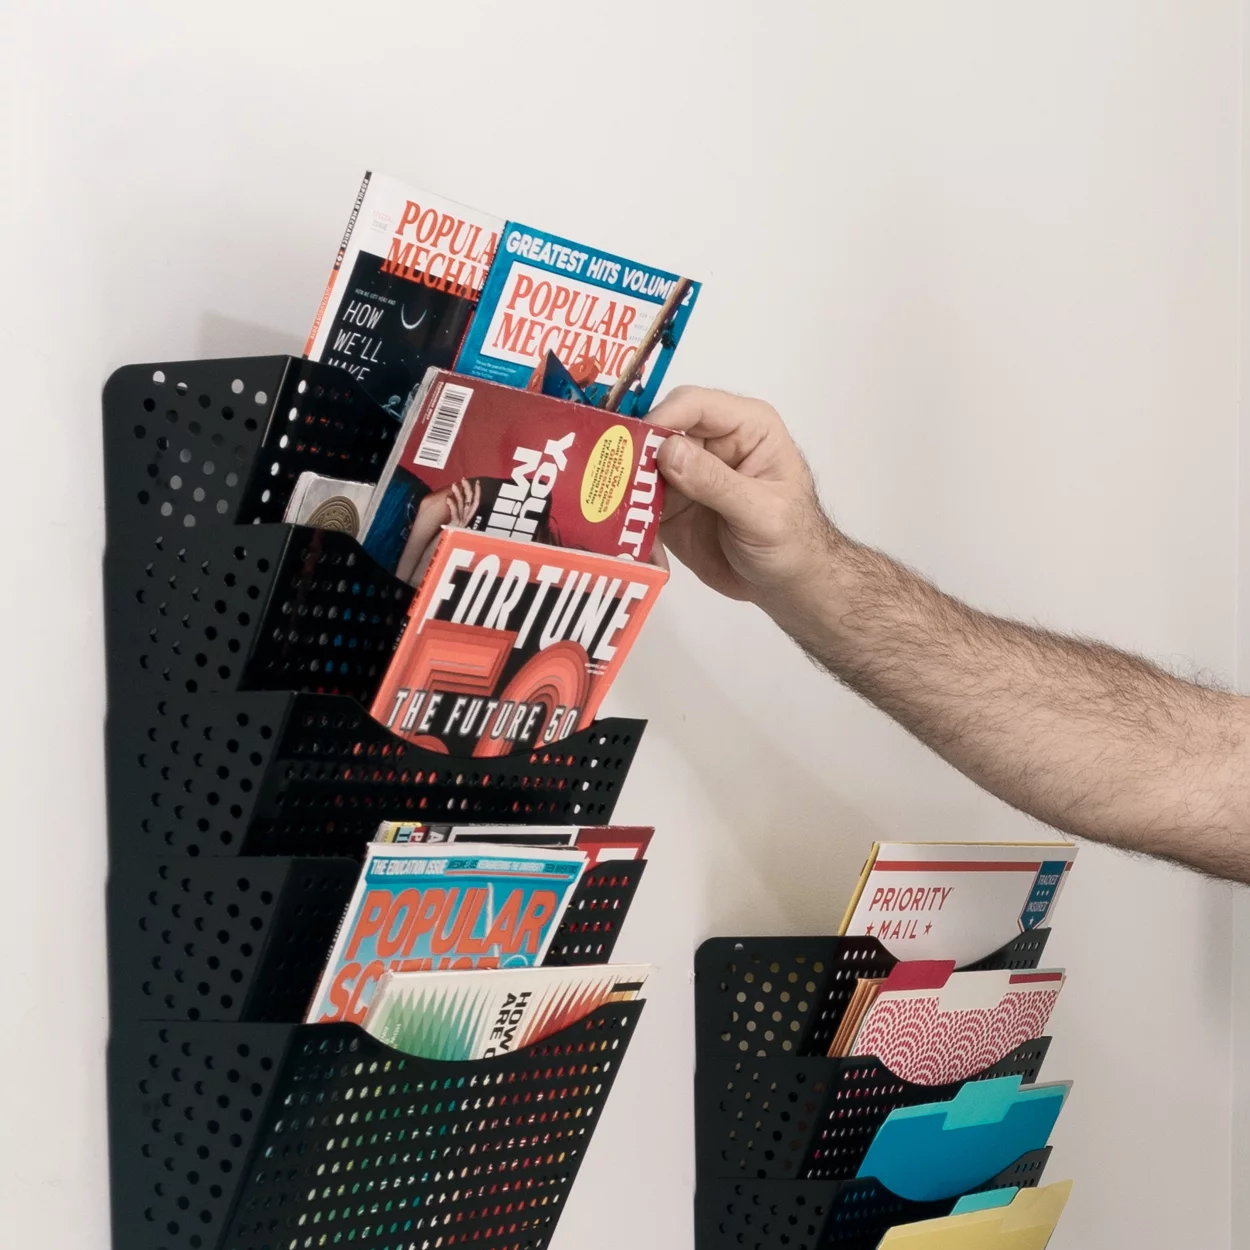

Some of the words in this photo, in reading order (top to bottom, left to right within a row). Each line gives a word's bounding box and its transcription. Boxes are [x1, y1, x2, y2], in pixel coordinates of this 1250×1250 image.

[506, 230, 588, 273] GREATEST
[586, 256, 621, 284] HITS
[681, 286, 694, 306] 2
[343, 300, 384, 330] HOW
[506, 273, 636, 341] POPULAR
[333, 329, 382, 363] WE'LL
[492, 312, 646, 379] MECHANIC
[616, 428, 666, 560] Entr
[416, 548, 649, 662] FORTUNE
[386, 690, 444, 732] THE
[442, 698, 542, 741] FUTURE
[543, 704, 580, 743] 50
[344, 887, 557, 960] POPULAR
[868, 887, 952, 911] PRIORITY
[877, 920, 918, 940] MAIL
[489, 993, 517, 1040] ARE
[499, 992, 532, 1051] HOW
